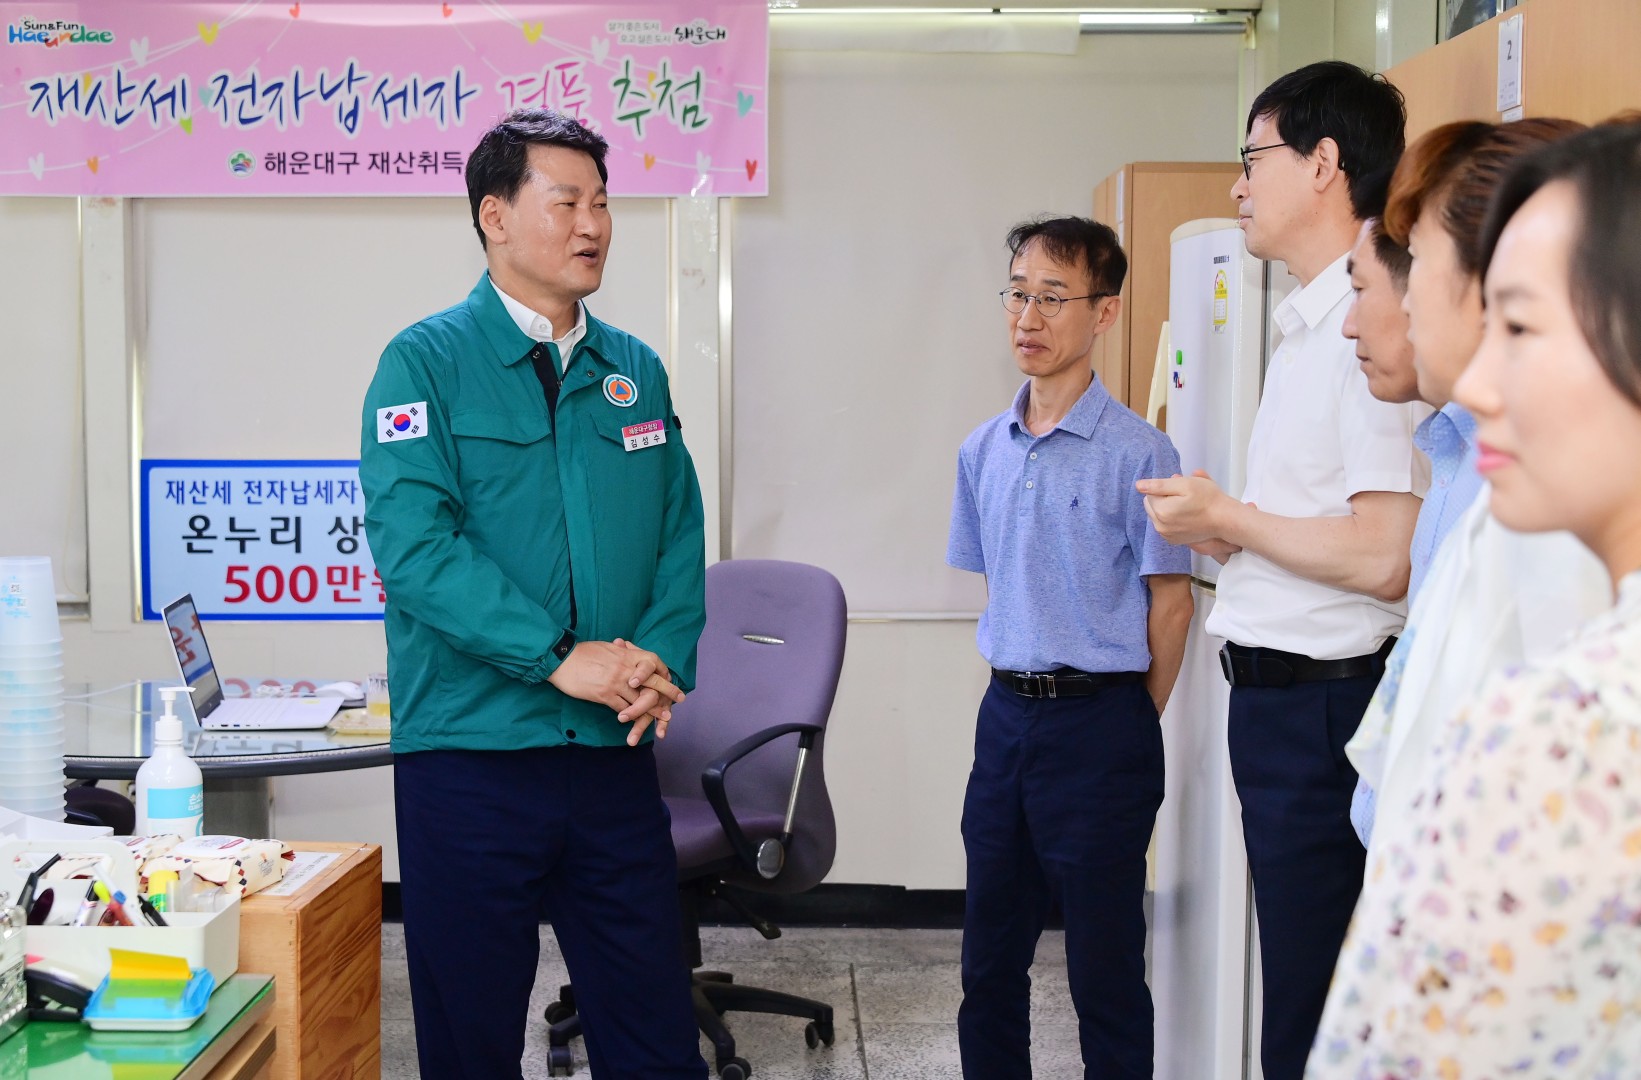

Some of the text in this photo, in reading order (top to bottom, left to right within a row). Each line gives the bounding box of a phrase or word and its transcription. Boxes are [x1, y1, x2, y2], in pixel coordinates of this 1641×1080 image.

[675, 26, 726, 45] 해운대
[29, 68, 187, 125] 재산세
[212, 61, 478, 134] 전자납세자
[613, 60, 709, 136] 추첨
[264, 151, 464, 175] 해운대구 재산취득
[165, 480, 358, 505] 재산세 전자납세자
[181, 514, 302, 554] 온누리
